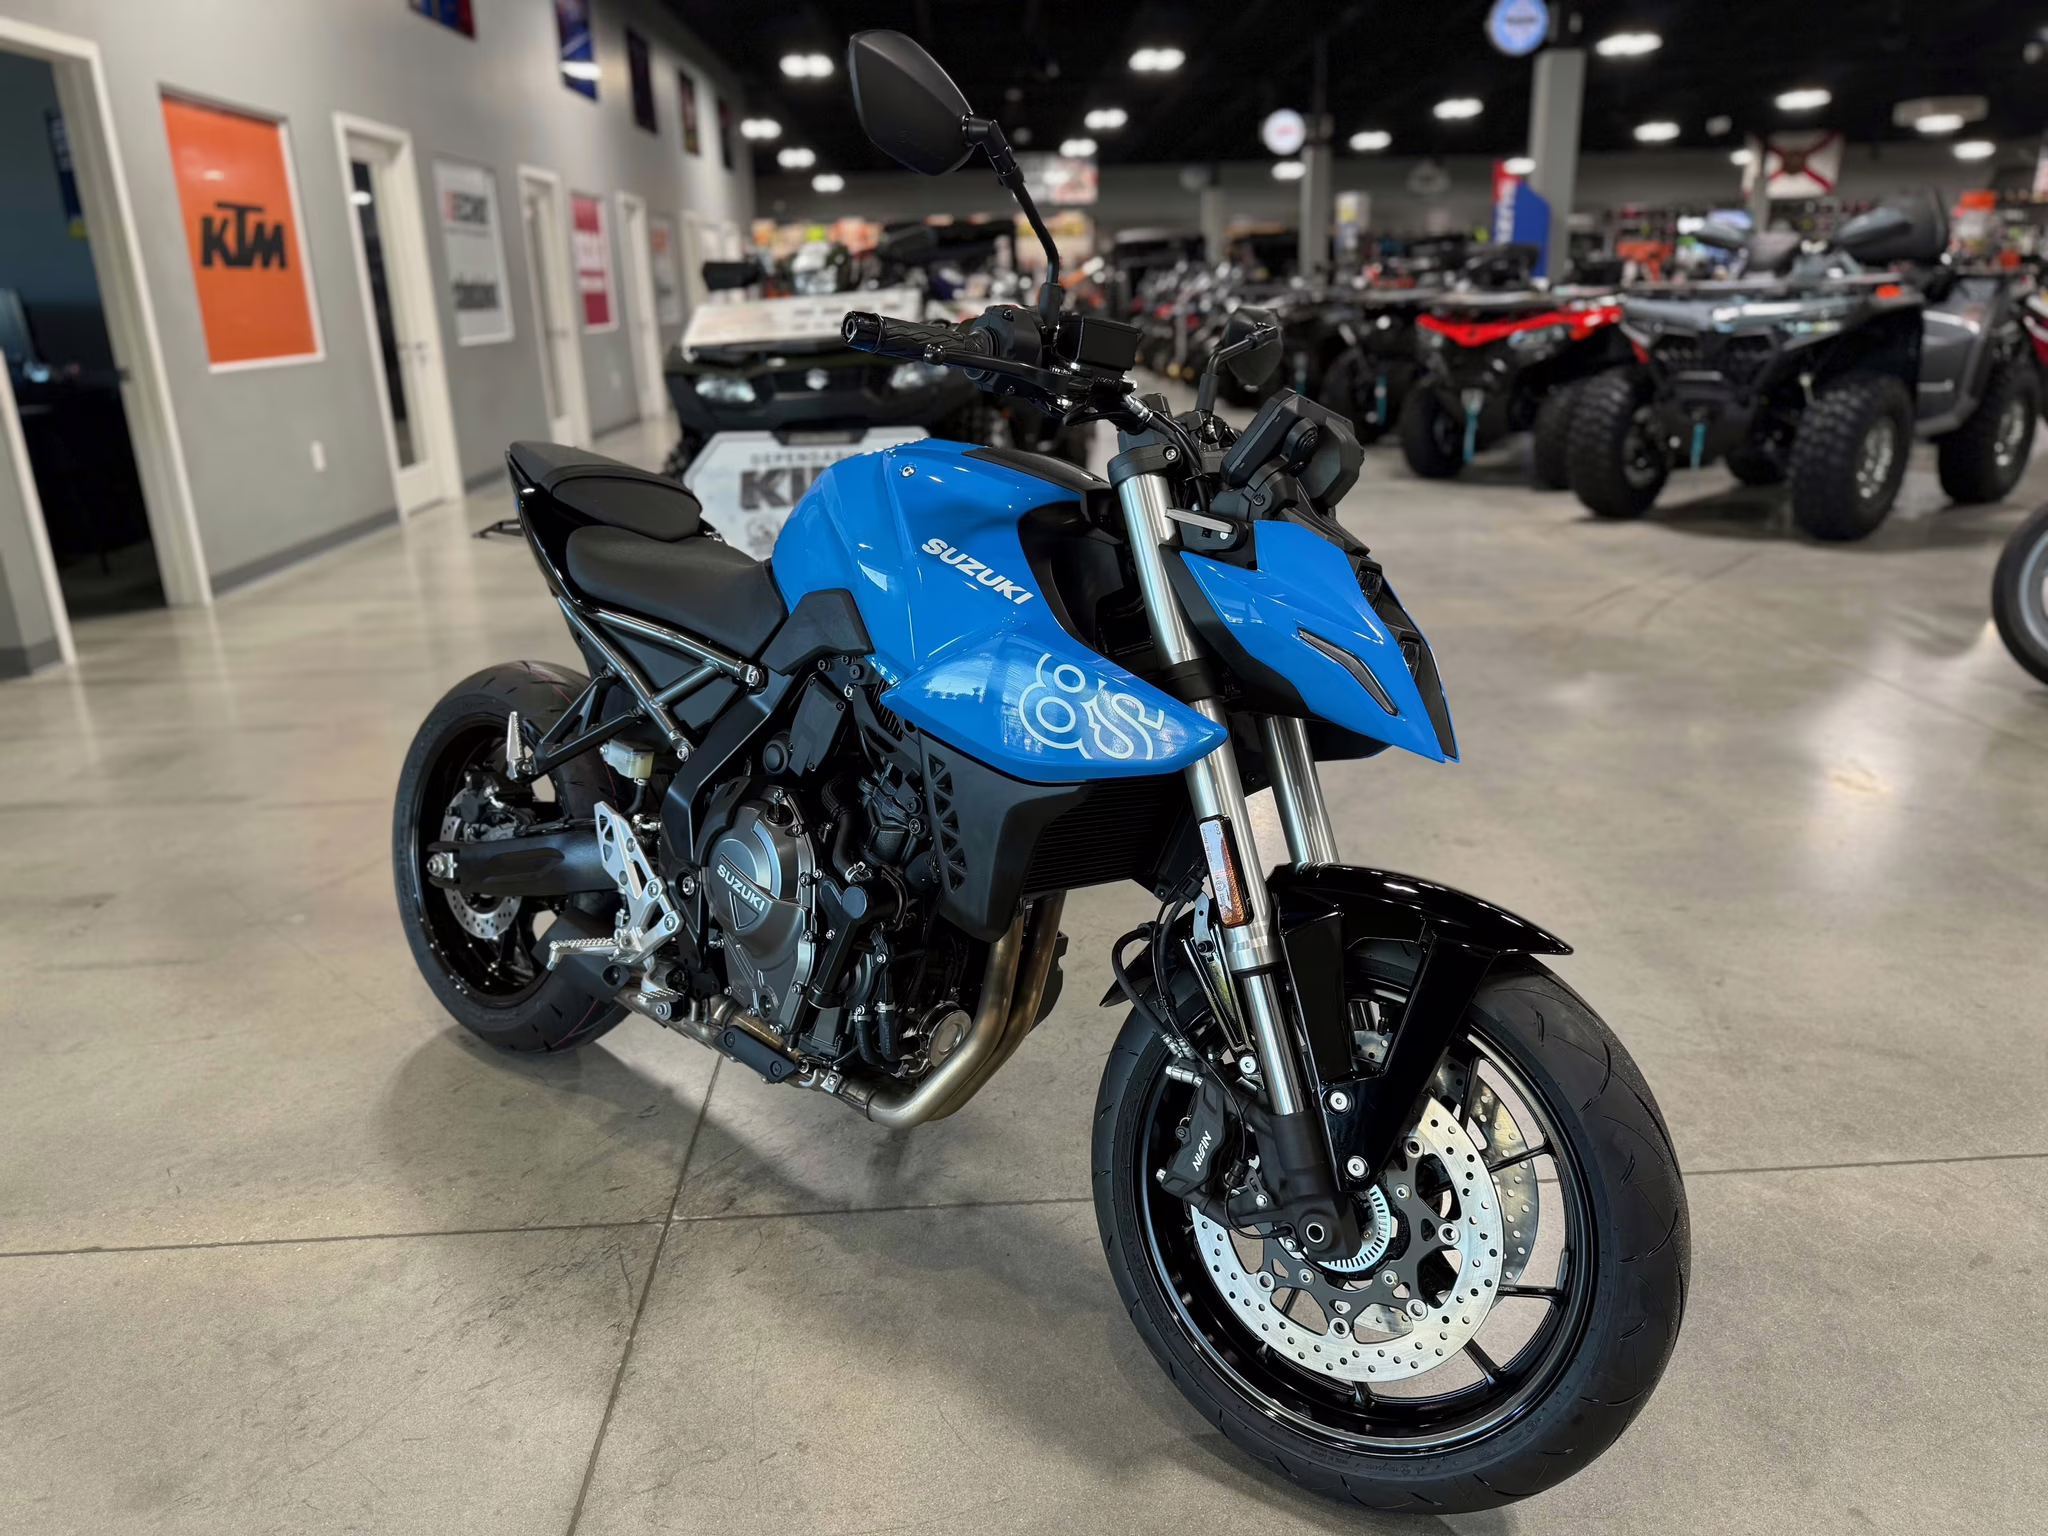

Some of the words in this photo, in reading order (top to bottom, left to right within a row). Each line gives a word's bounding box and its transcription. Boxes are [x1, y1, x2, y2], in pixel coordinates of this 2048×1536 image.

[202, 201, 287, 270] KTM
[741, 464, 825, 510] KI
[921, 538, 1034, 605] SUZUKI
[716, 864, 766, 912] SUZUKI
